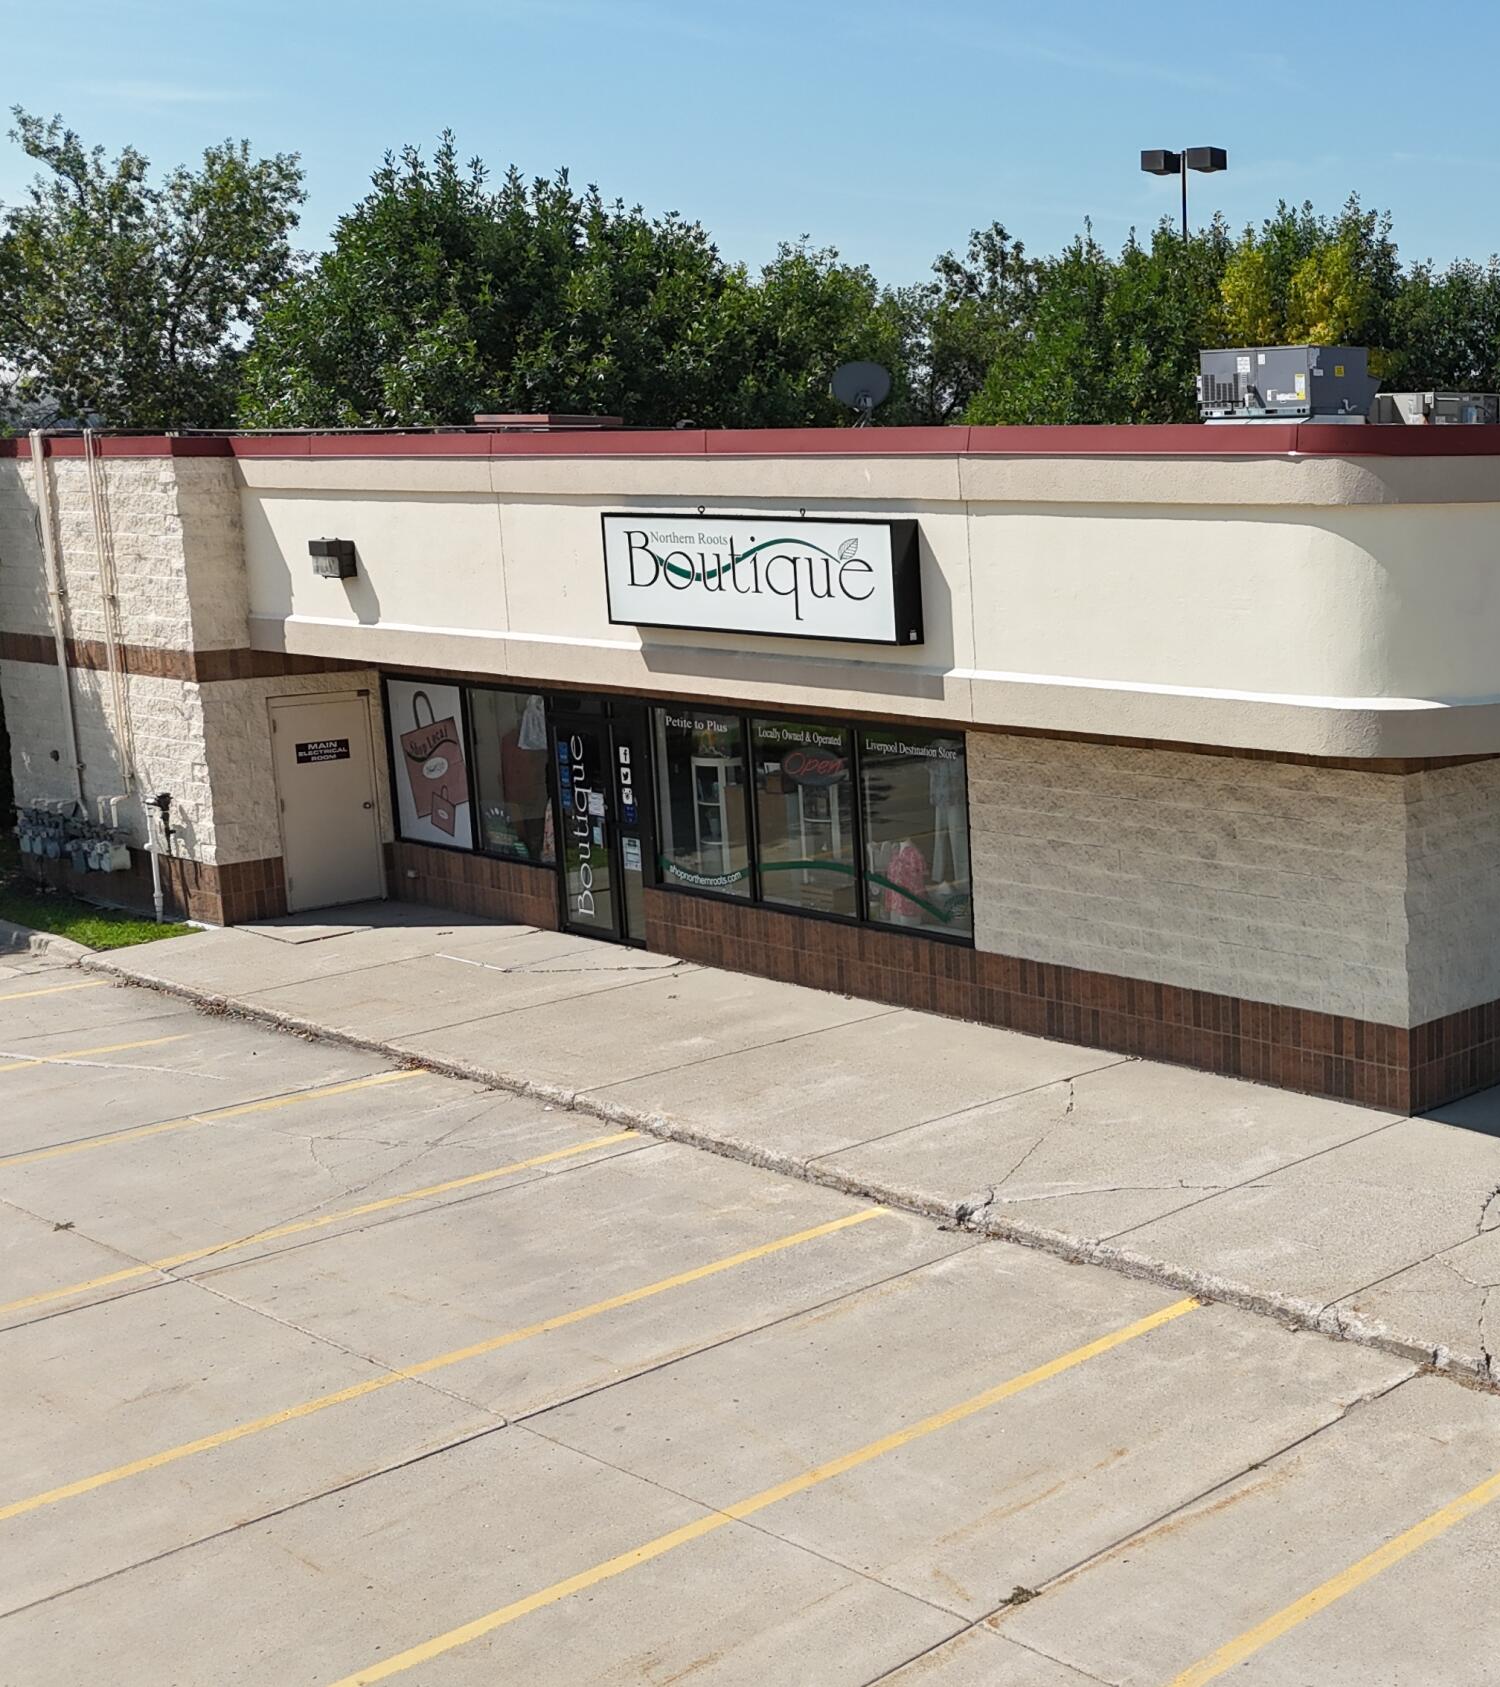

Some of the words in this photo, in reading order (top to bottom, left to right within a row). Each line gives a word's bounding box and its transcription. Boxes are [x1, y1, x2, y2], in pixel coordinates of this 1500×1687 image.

[650, 531, 695, 545] Northern
[698, 532, 729, 546] Roots
[623, 530, 876, 621] Boutique
[665, 715, 693, 729] Petite
[694, 720, 705, 731] to
[706, 720, 728, 733] Plus
[308, 741, 339, 750] MAIN
[758, 727, 781, 742] Locally
[782, 729, 804, 742] Owned
[805, 732, 812, 743] &
[812, 732, 842, 746] Operated
[298, 747, 348, 757] ELECTRICAL
[311, 754, 337, 762] ROOM
[866, 739, 897, 754] Liverpool
[899, 742, 937, 757] Destination
[938, 747, 957, 760] Store
[784, 752, 848, 775] Open
[570, 735, 597, 918] Boutique
